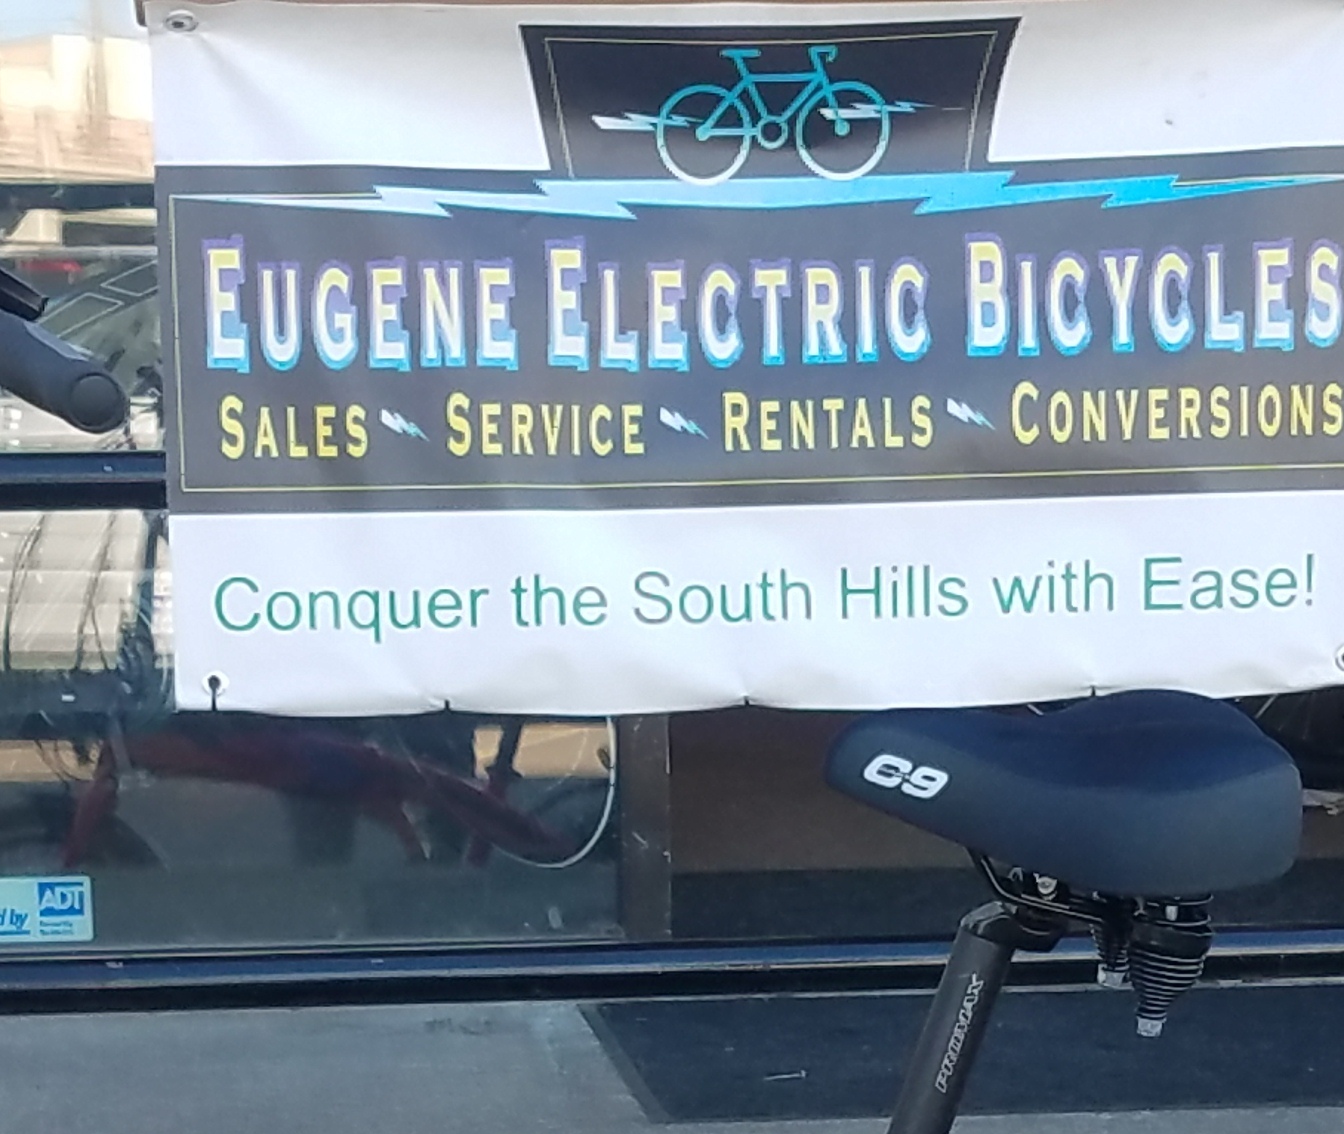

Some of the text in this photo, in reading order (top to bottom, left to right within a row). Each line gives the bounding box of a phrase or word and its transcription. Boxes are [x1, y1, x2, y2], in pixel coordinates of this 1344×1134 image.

[203, 233, 1344, 372] EUGENE ELECTRIC BICYCLES
[220, 381, 1344, 459] SALES SERVICE RENTALS CONVERSIONS
[214, 576, 490, 643] Conquer
[510, 573, 608, 627] the
[632, 567, 812, 624] South
[841, 564, 970, 619] Hills
[992, 559, 1115, 614] with
[1143, 552, 1316, 611] Ease!
[10, 908, 29, 930] by
[39, 885, 83, 911] ADT
[935, 973, 984, 1093] PROMAX
